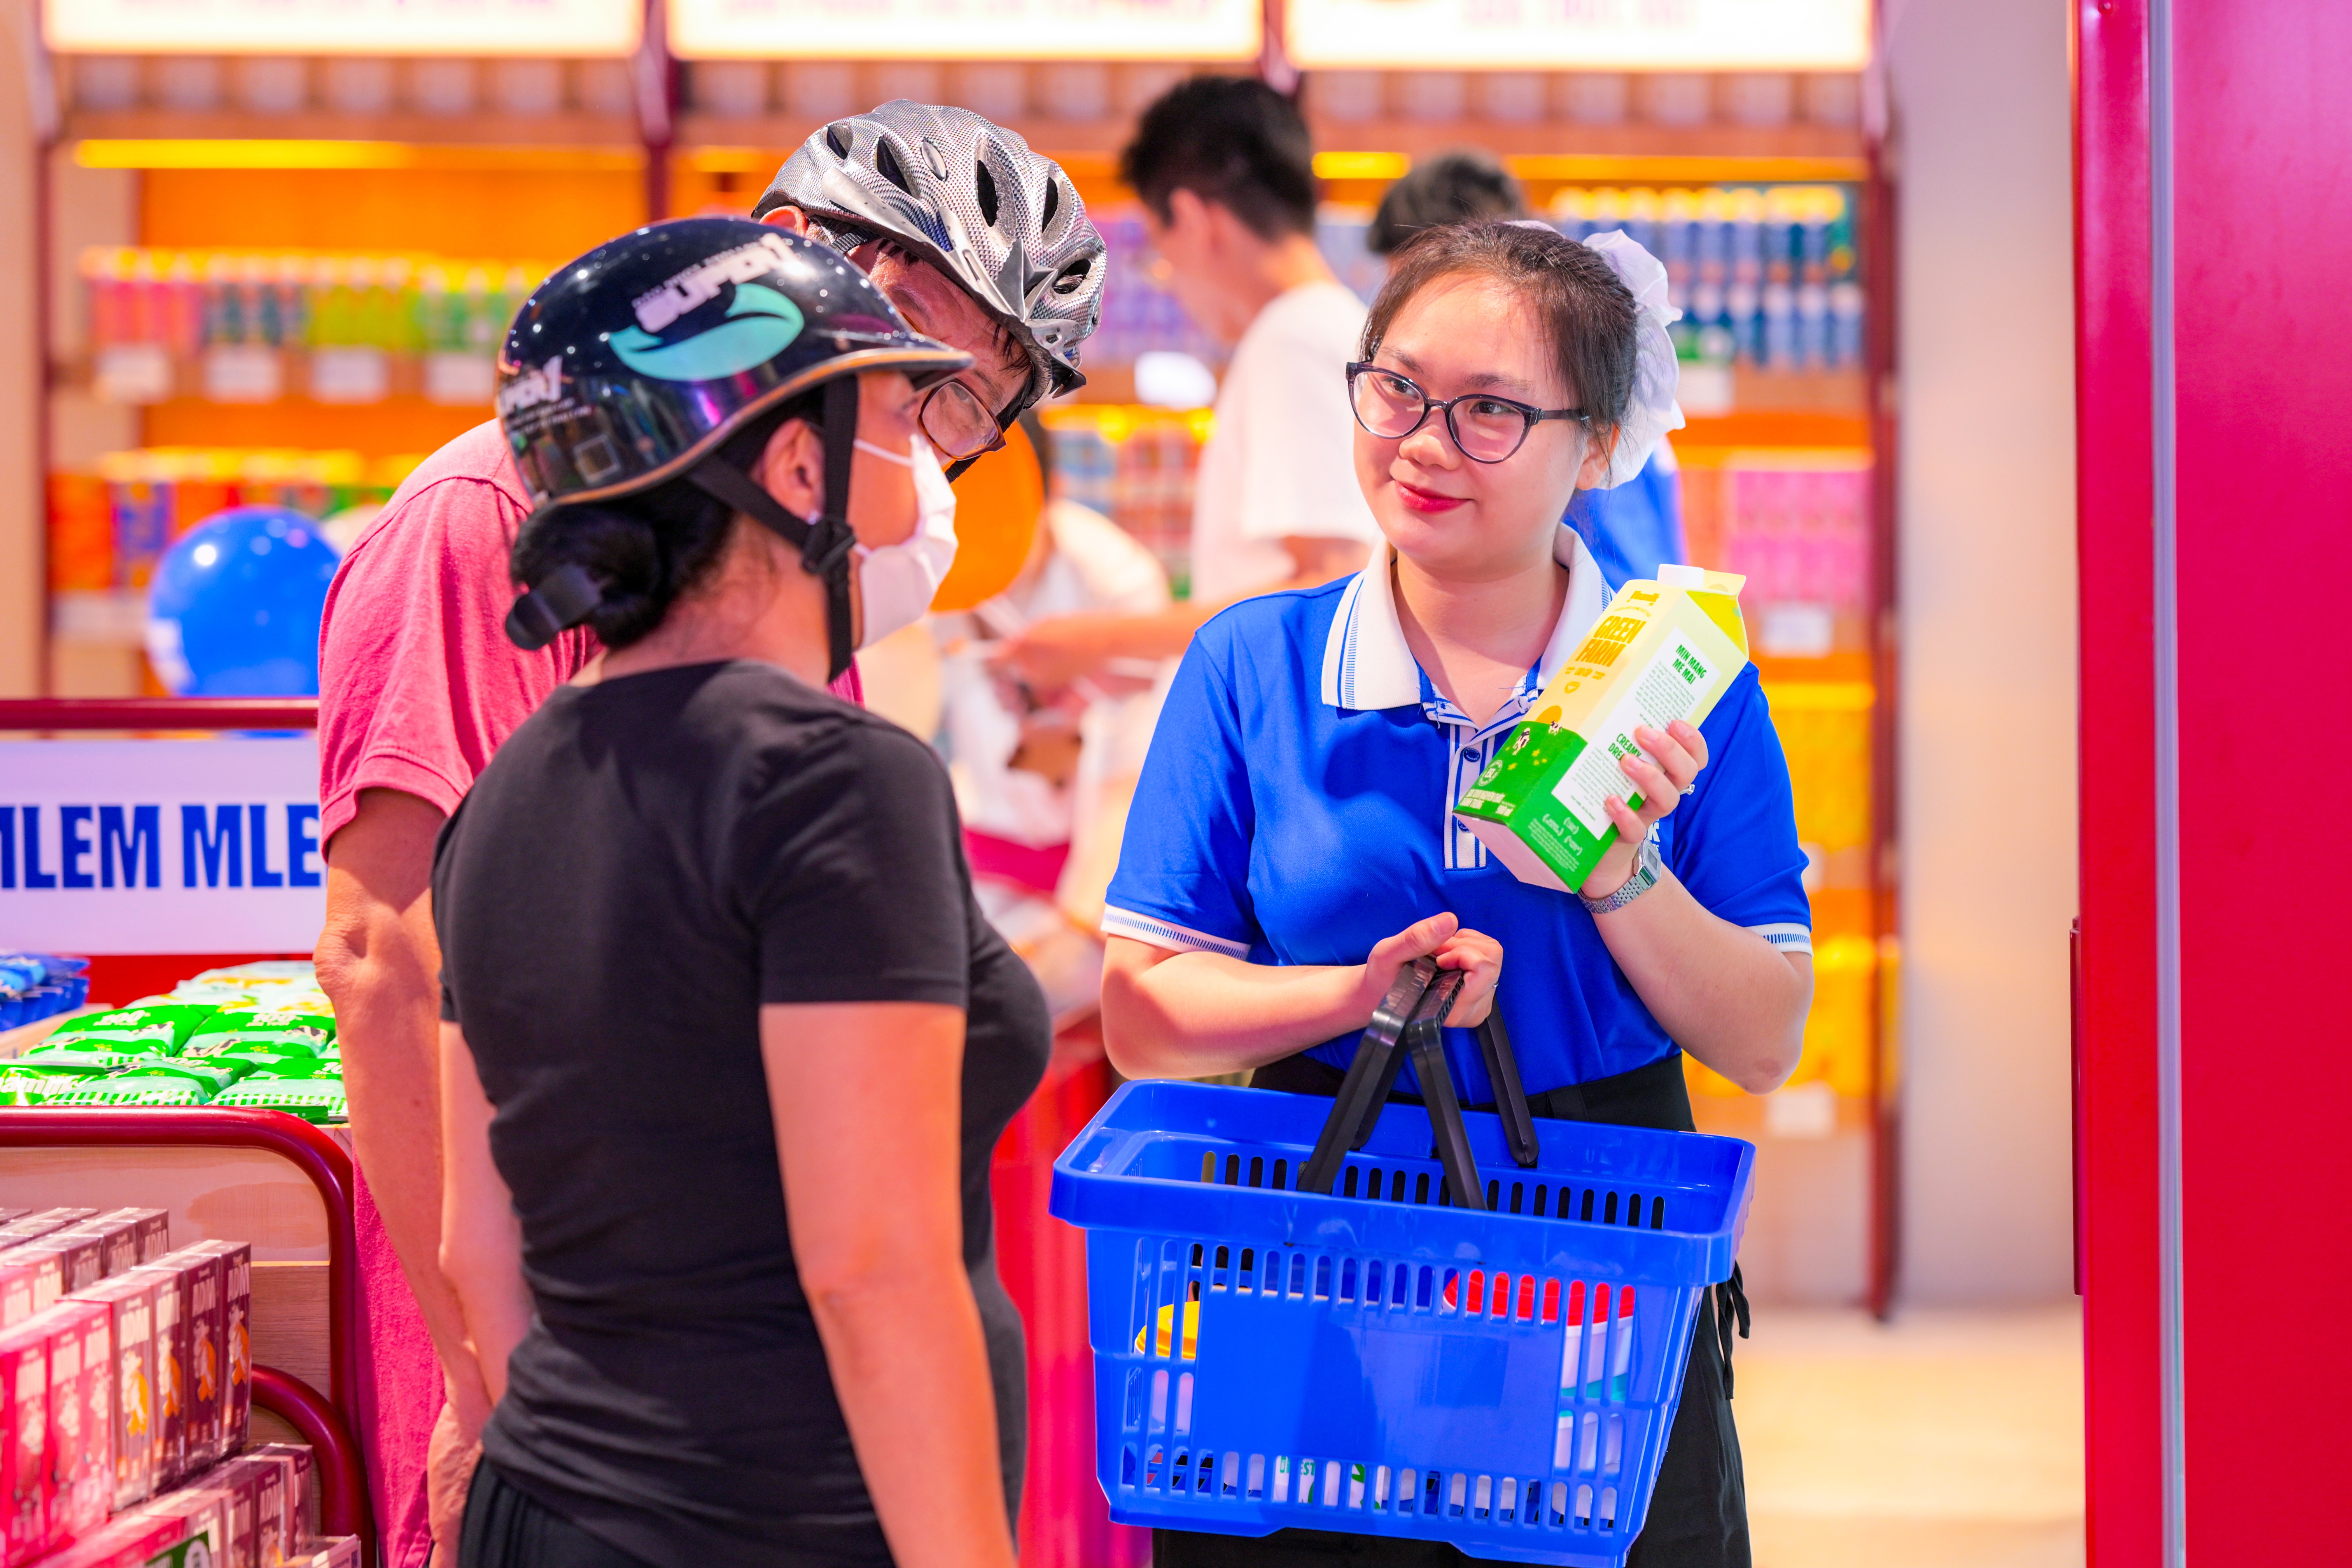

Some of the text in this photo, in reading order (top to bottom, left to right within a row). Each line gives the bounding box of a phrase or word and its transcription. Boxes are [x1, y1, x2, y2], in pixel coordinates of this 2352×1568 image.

[1593, 615, 1647, 644] GREEN
[1575, 639, 1627, 667] FARM
[1616, 733, 1642, 758] CREAMY
